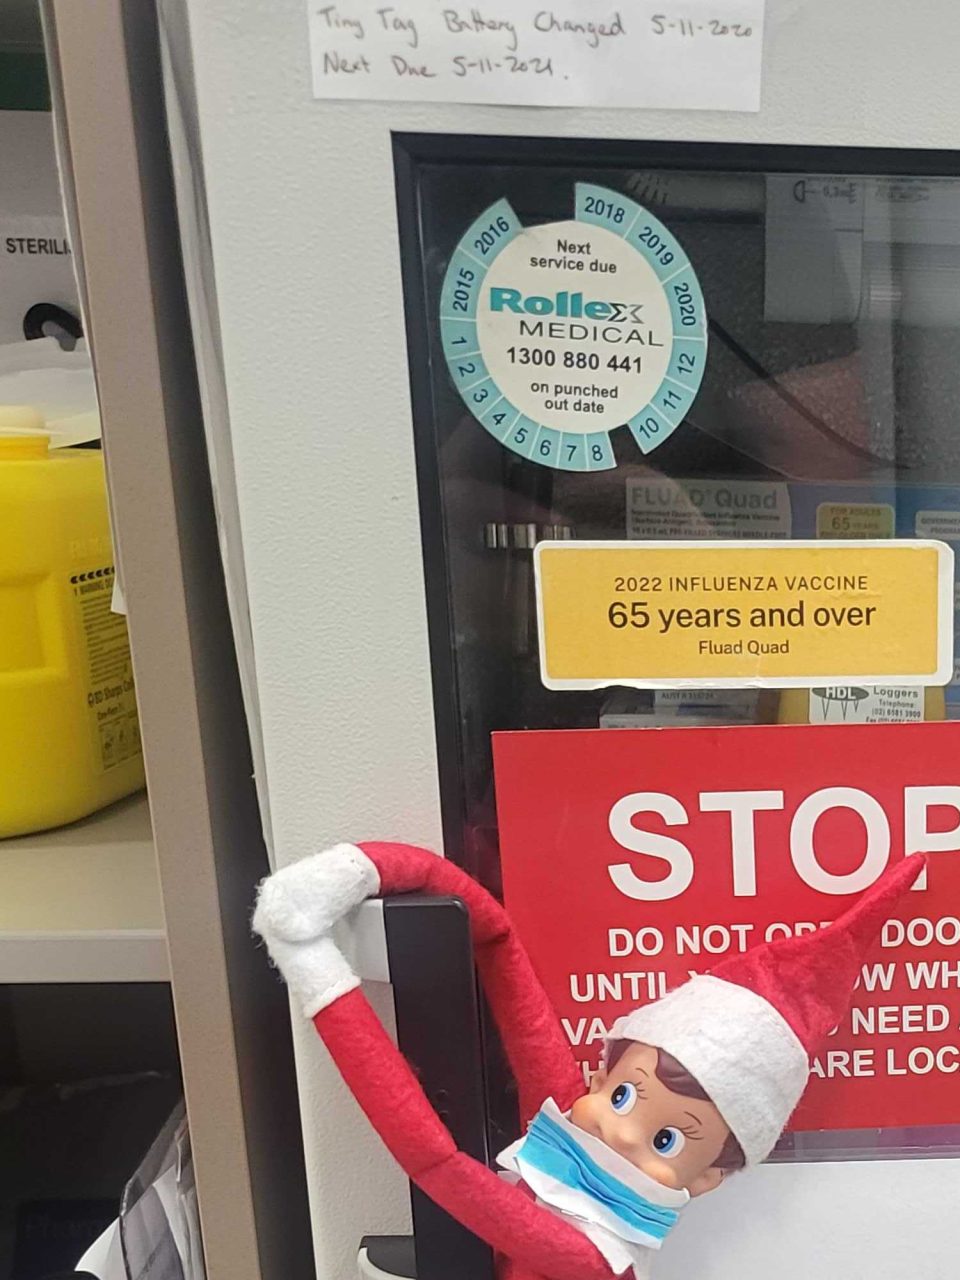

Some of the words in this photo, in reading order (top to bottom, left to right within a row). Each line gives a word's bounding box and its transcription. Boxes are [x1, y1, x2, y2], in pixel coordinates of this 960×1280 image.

[318, 6, 364, 40] Tiny
[379, 7, 418, 47] Tag
[534, 12, 627, 48] Changed
[650, 13, 753, 38] 5-11-2020
[322, 56, 371, 75] Next
[395, 57, 437, 78] Due
[583, 196, 625, 224] 2018
[474, 216, 510, 255] 2016
[557, 239, 591, 255] Next
[638, 226, 674, 267] 2019
[530, 256, 584, 272] service
[589, 259, 617, 274] due
[453, 267, 475, 312] 2015
[673, 282, 697, 327] 2020
[519, 320, 664, 347] MEDICAL
[458, 363, 476, 377] 2
[506, 346, 556, 368] 1300
[563, 351, 600, 371] 880
[607, 355, 642, 374] 441
[678, 352, 697, 375] 12
[472, 388, 489, 404] 3
[530, 382, 549, 394] on
[554, 381, 618, 399] punched
[663, 390, 682, 411] 11
[544, 398, 568, 412] out
[573, 400, 605, 414] date
[491, 411, 507, 427] 4
[638, 417, 660, 440] 10
[514, 427, 529, 444] 5
[539, 440, 552, 457] 6
[566, 445, 577, 462] 7
[592, 445, 603, 462] 8
[715, 487, 777, 510] Quad
[831, 517, 850, 530] 65
[614, 577, 663, 593] 2022
[669, 576, 779, 593] INFLUENZA
[785, 575, 869, 592] VACCINE
[608, 601, 650, 630] 65
[657, 604, 742, 633] years
[750, 600, 805, 628] and
[813, 605, 877, 627] over
[699, 639, 743, 656] Fluad
[747, 639, 790, 656] Quad
[825, 687, 857, 700] HDL
[874, 686, 919, 699] Loggers
[879, 699, 914, 708] Telephone
[608, 927, 664, 957] DO
[676, 924, 754, 955] NOT
[569, 971, 668, 1002] UNTIL
[851, 1004, 950, 1035] NEED
[808, 1048, 875, 1080] ARE
